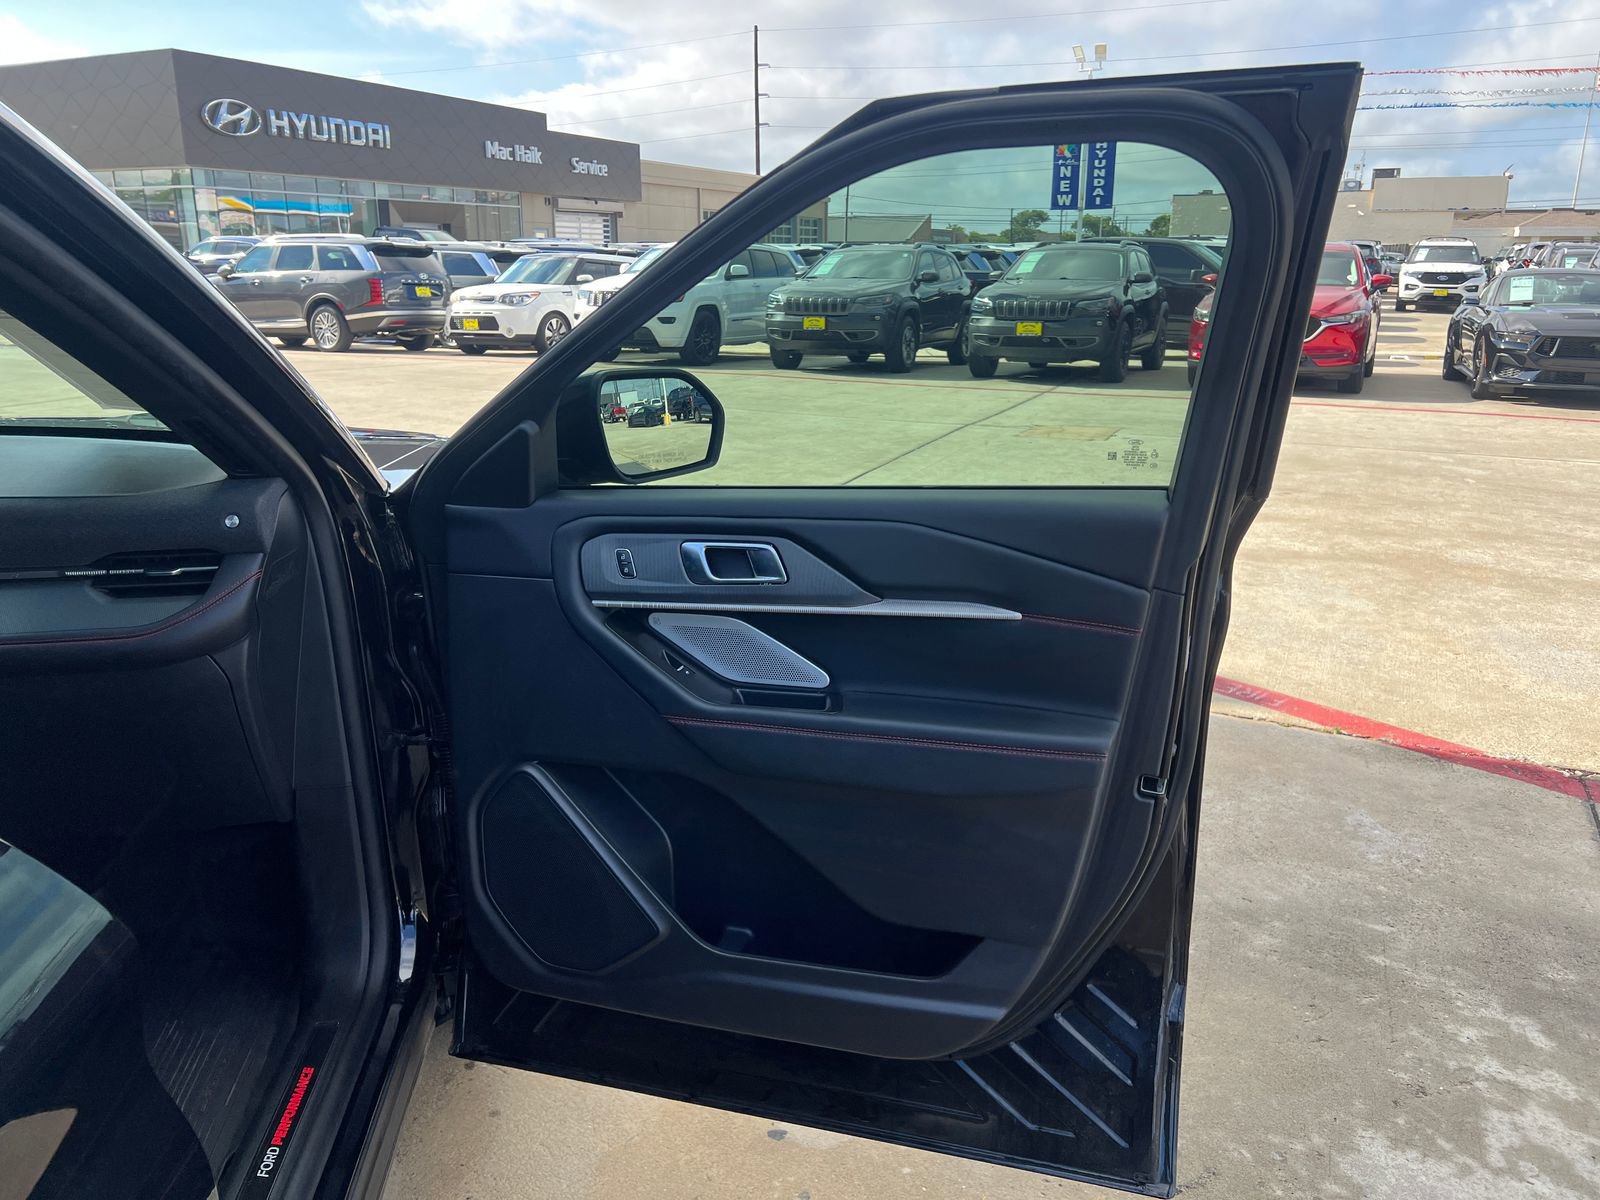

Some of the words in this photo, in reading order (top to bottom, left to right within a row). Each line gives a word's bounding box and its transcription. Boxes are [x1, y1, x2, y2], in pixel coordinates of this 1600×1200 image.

[266, 109, 391, 149] HYUNDAI
[484, 140, 514, 161] Mac
[514, 144, 543, 165] Haik
[571, 157, 609, 177] Service
[1057, 166, 1072, 206] NEW
[1092, 142, 1108, 205] HYUNDAI
[257, 1146, 280, 1178] FORD
[271, 1067, 315, 1145] PERFORMANCE
